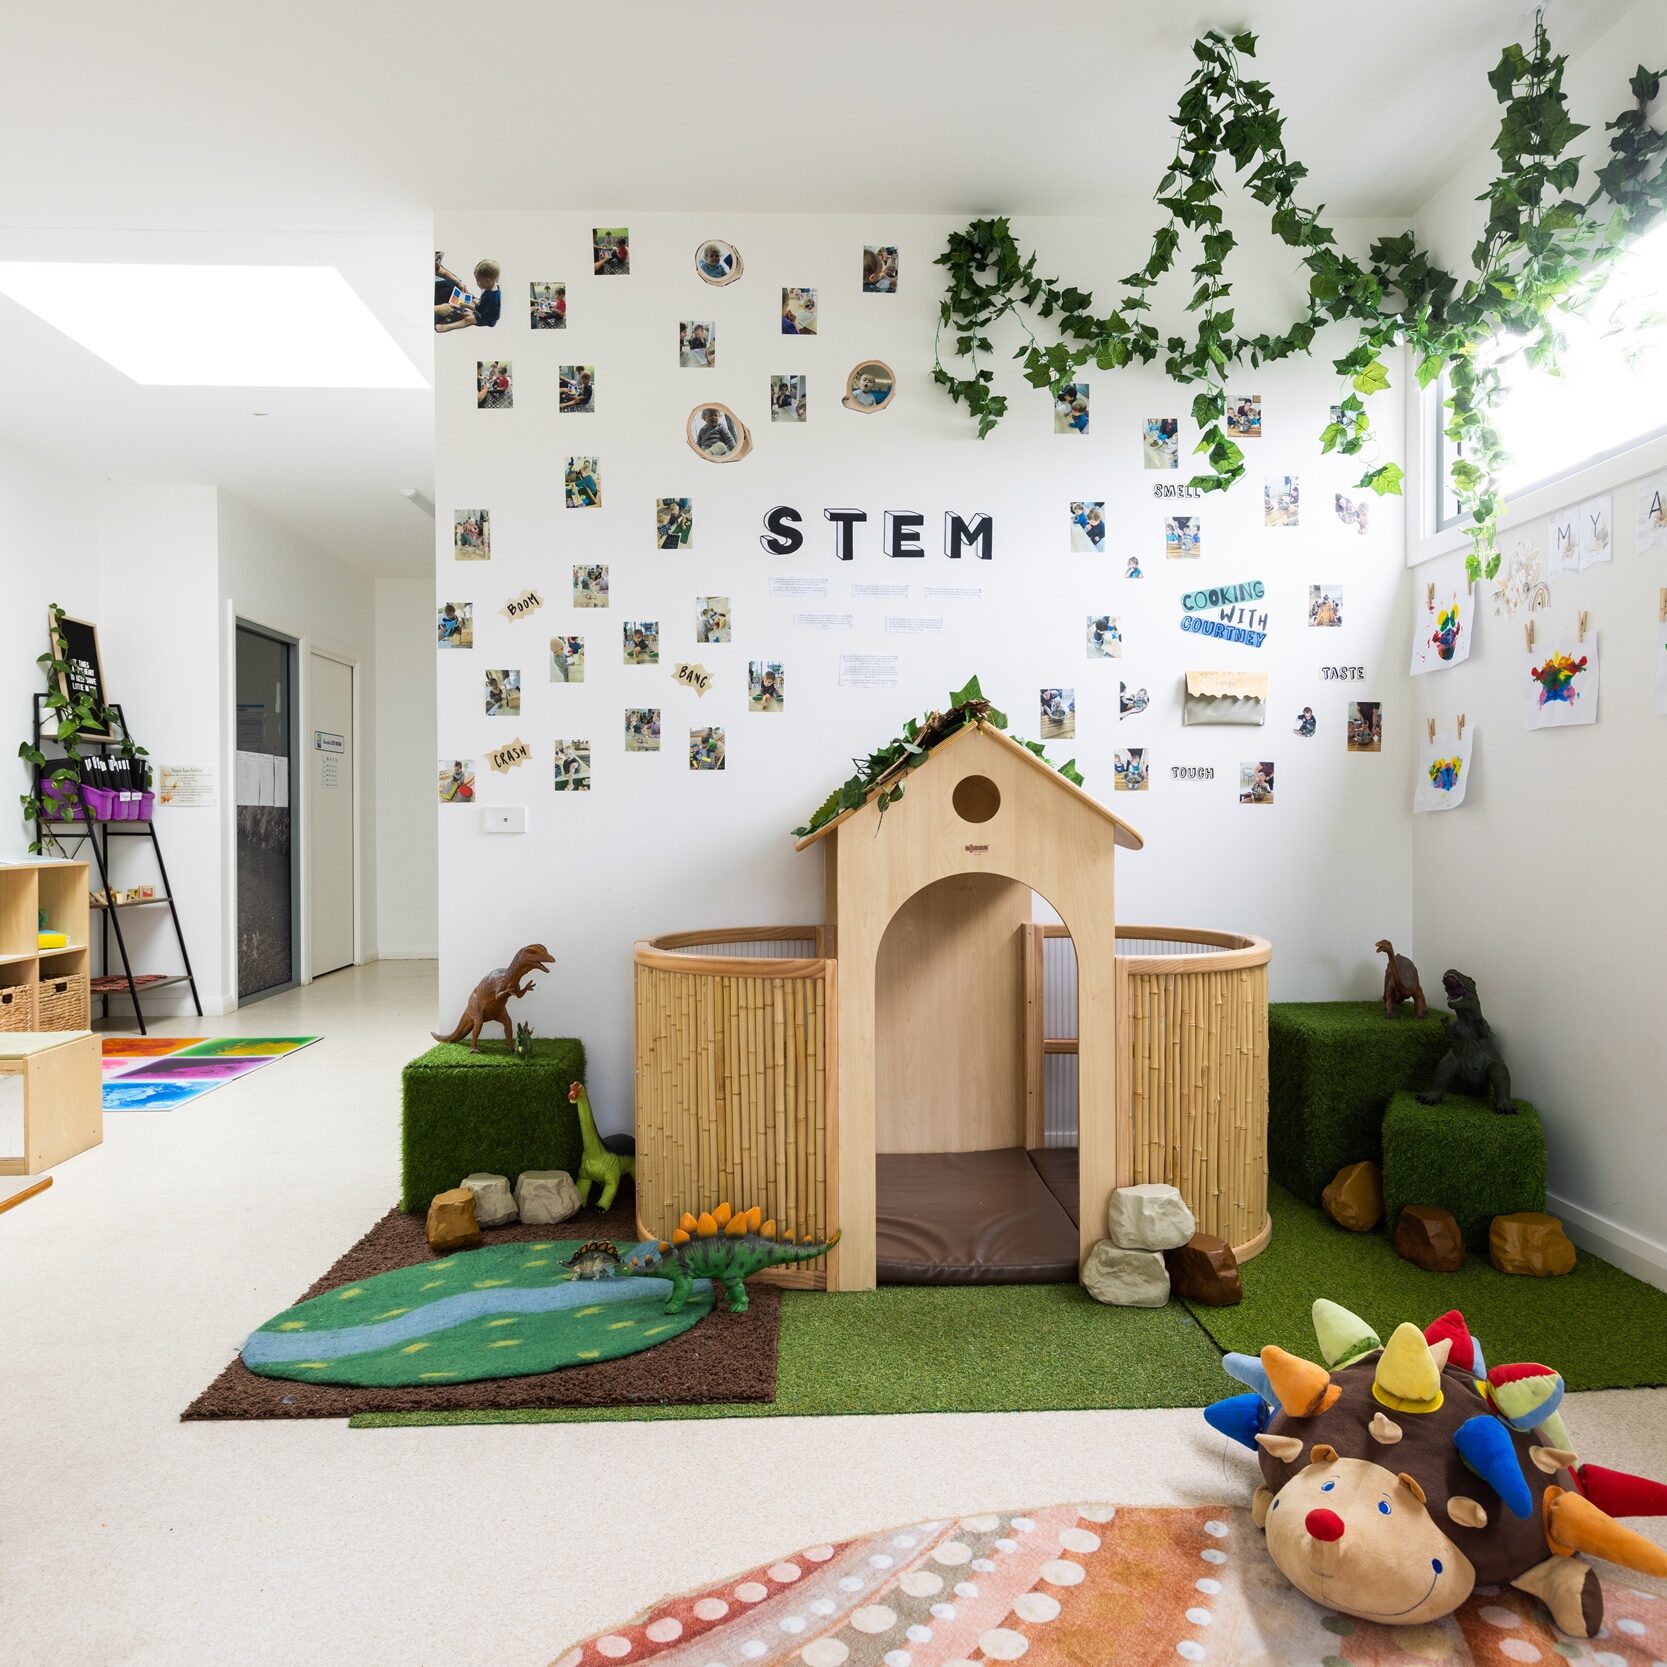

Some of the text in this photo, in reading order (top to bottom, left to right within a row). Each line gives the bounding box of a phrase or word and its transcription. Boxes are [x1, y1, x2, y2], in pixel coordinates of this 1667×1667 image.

[1153, 483, 1201, 499] SMELL
[760, 505, 993, 561] STEM
[506, 592, 540, 616] BOOM
[1183, 581, 1265, 611] COOKING
[1220, 605, 1268, 631] WITH
[1181, 615, 1267, 648] COURTNEY
[678, 665, 708, 689] BANG
[1321, 666, 1365, 681] TASTE
[493, 745, 527, 768] CRASH
[1171, 766, 1214, 780] TOUCH
